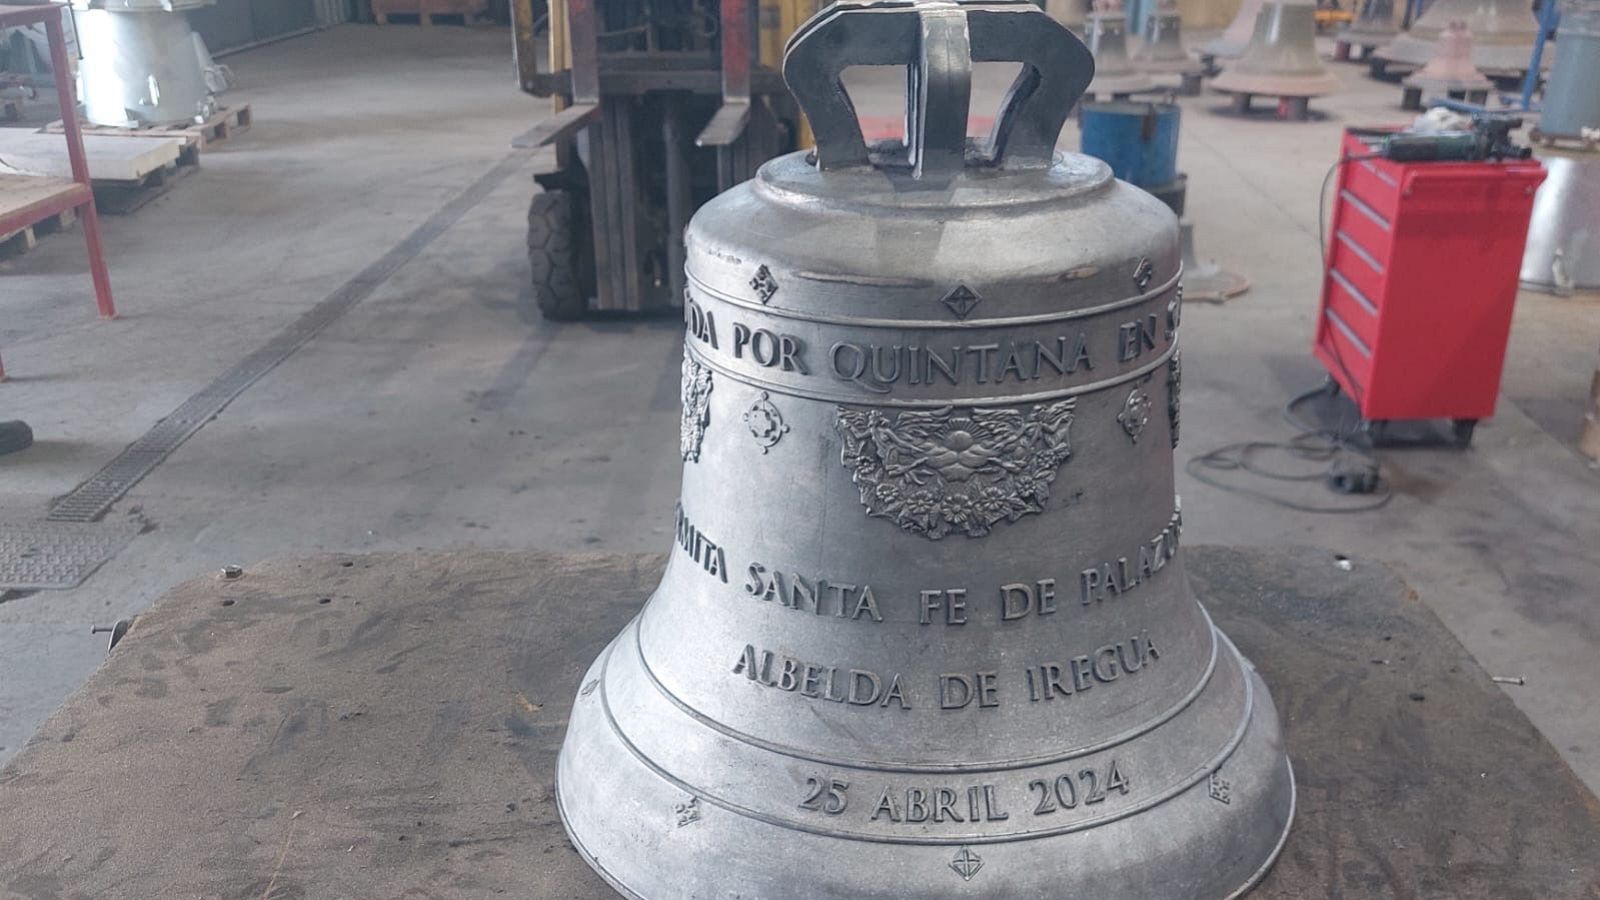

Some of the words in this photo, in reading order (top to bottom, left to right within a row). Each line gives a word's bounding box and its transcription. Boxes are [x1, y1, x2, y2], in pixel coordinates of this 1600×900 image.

[732, 321, 808, 375] POR
[830, 332, 1095, 393] QUINTANA
[1118, 312, 1157, 362] EN
[745, 562, 883, 622] SANTA
[919, 588, 968, 625] FE
[1000, 578, 1056, 621] DE
[732, 643, 913, 711] ALBELDA
[940, 670, 1000, 710] DE
[1026, 628, 1160, 703] IREGUA
[797, 777, 850, 815] 25
[870, 785, 1009, 822] ABRIL
[1028, 759, 1129, 816] 2024
